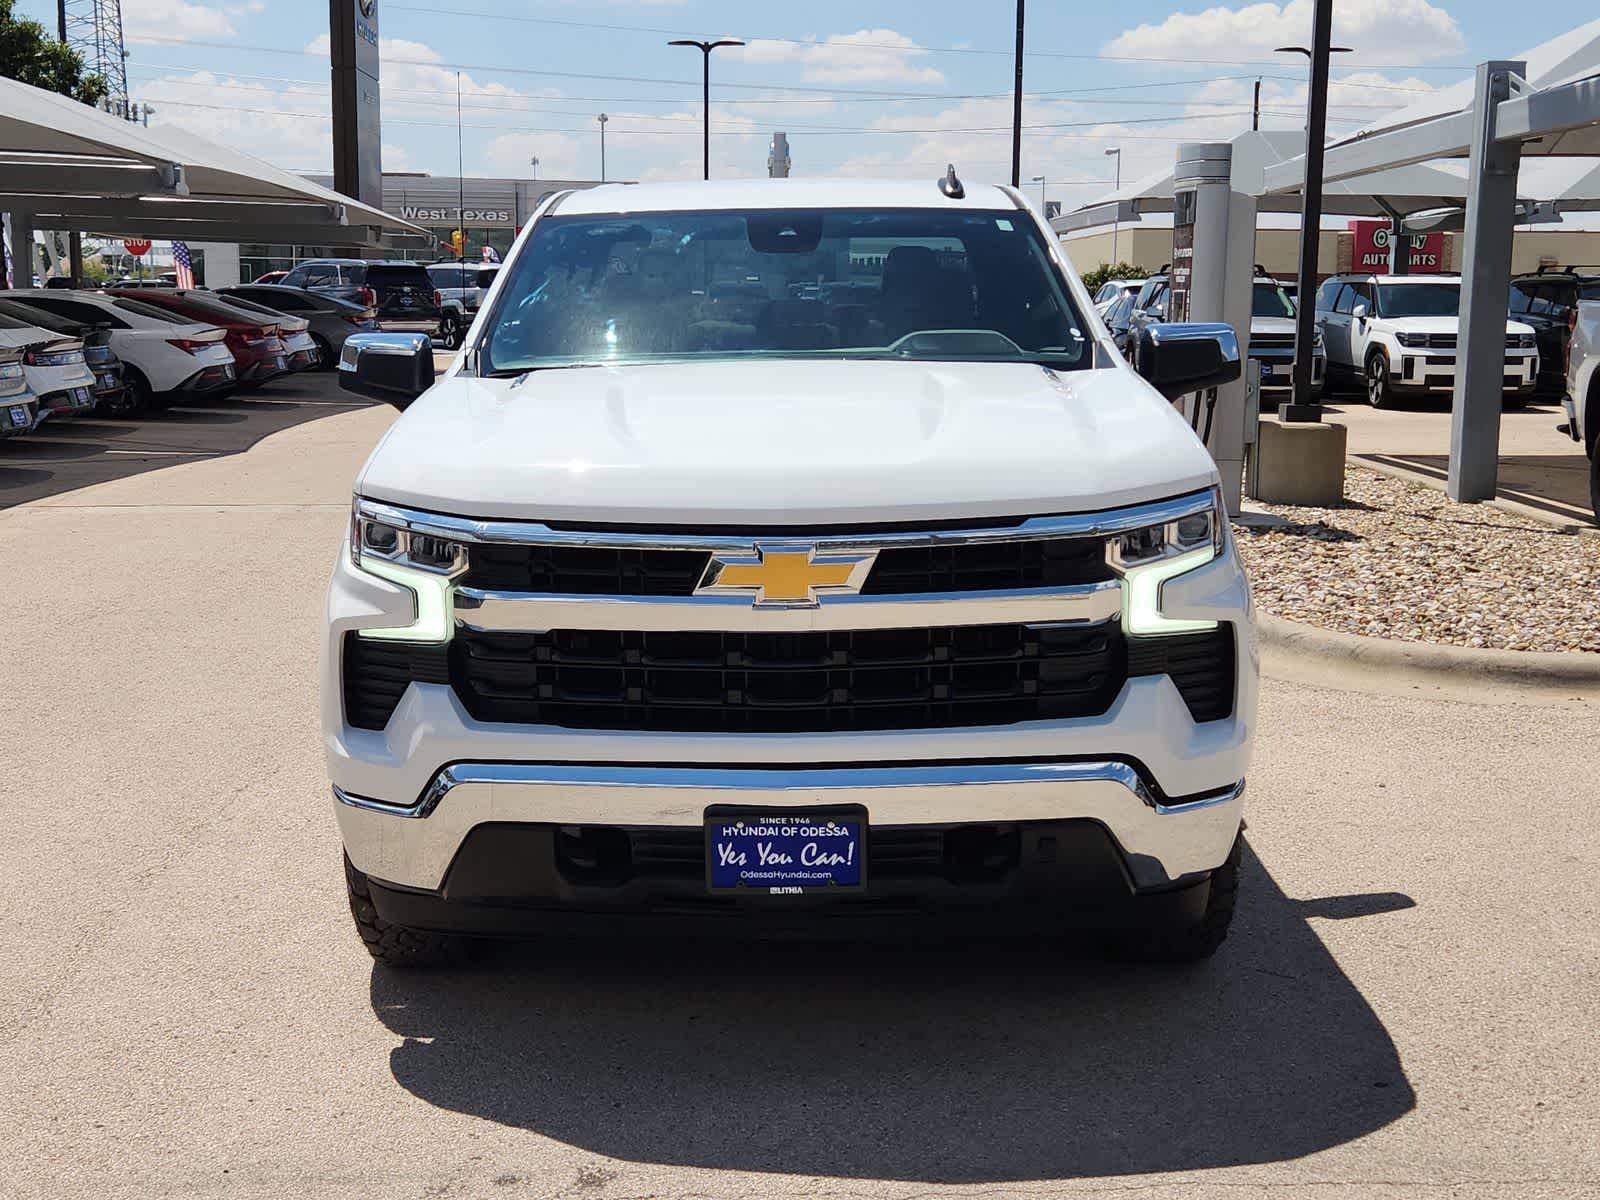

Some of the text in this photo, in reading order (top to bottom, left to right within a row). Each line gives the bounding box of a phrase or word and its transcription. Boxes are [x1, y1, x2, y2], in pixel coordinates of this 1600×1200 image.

[401, 207, 509, 221] West Texas
[722, 826, 849, 837] HYUNDAI OF ODESSA
[717, 841, 855, 867] Yes You Can!
[740, 870, 832, 880] OdessaHyundai.com
